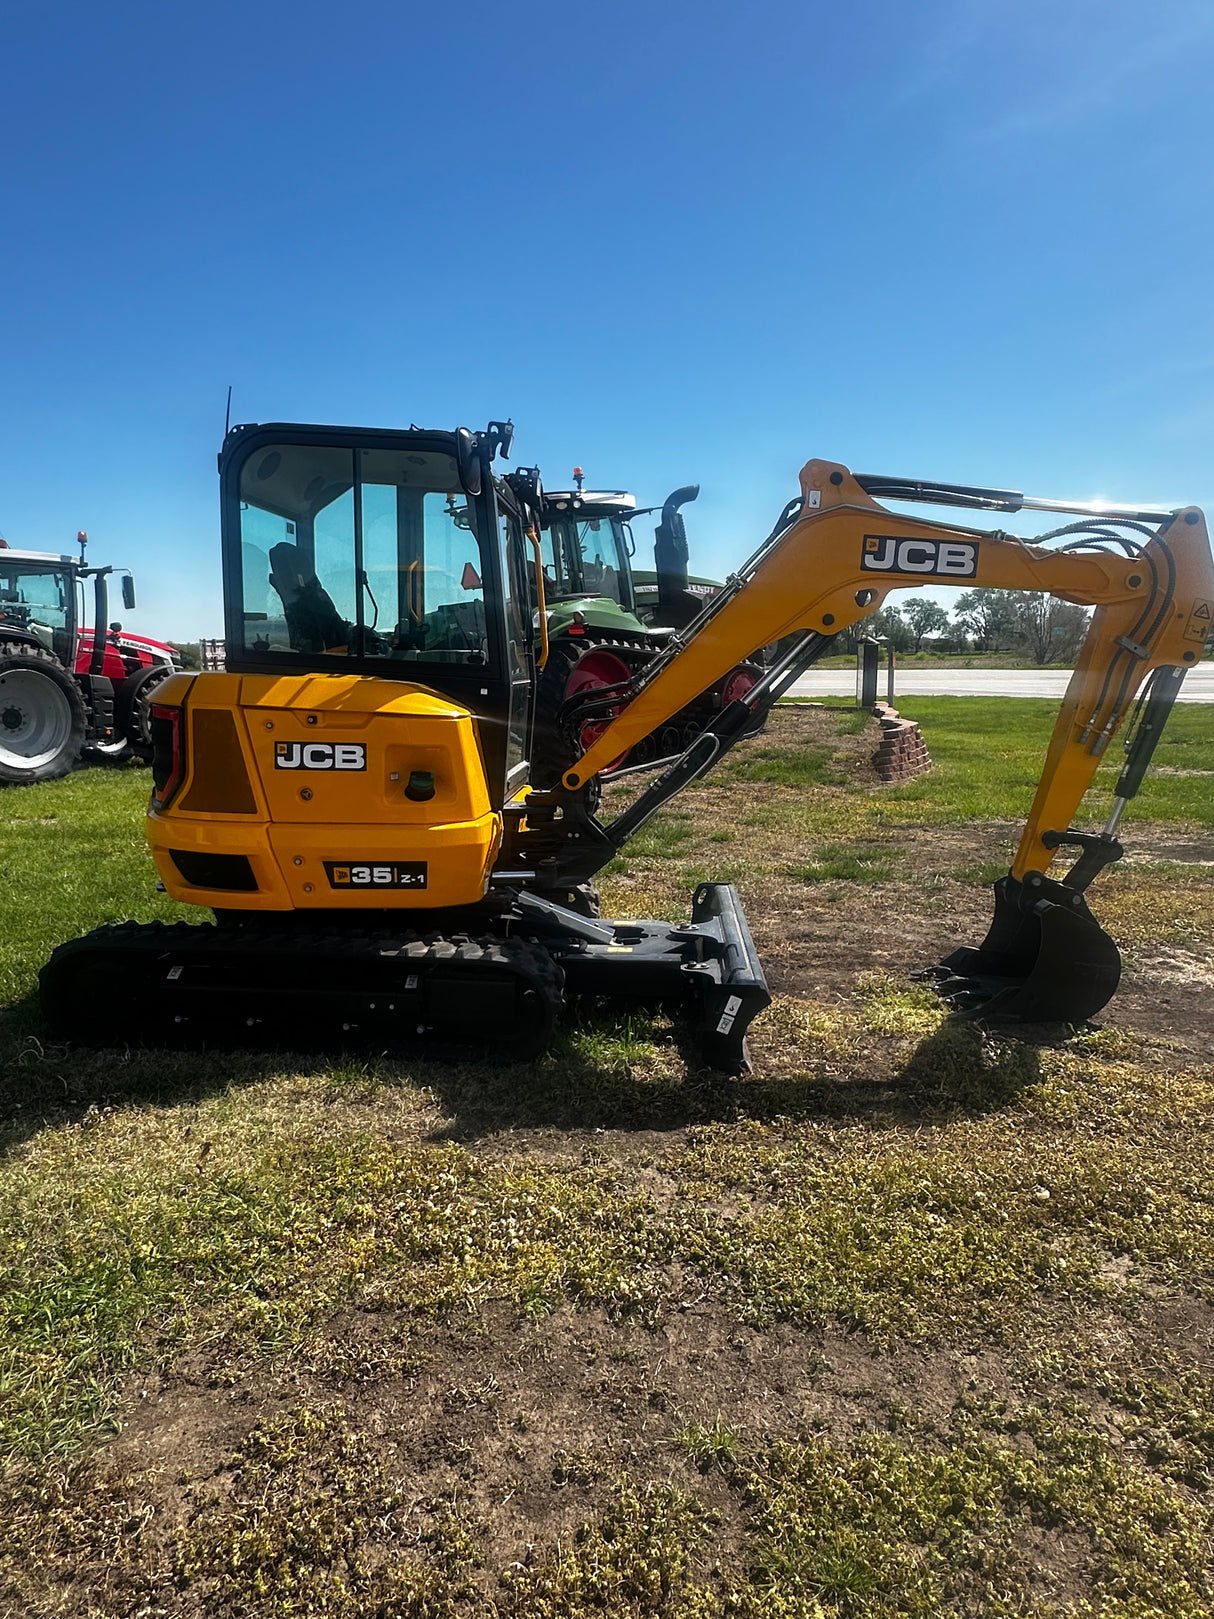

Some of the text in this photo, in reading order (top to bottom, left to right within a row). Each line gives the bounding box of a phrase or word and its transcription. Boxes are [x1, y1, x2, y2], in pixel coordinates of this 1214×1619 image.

[864, 540, 975, 575] JCB
[277, 743, 365, 769] JCB
[351, 866, 425, 883] 35 Z-1
